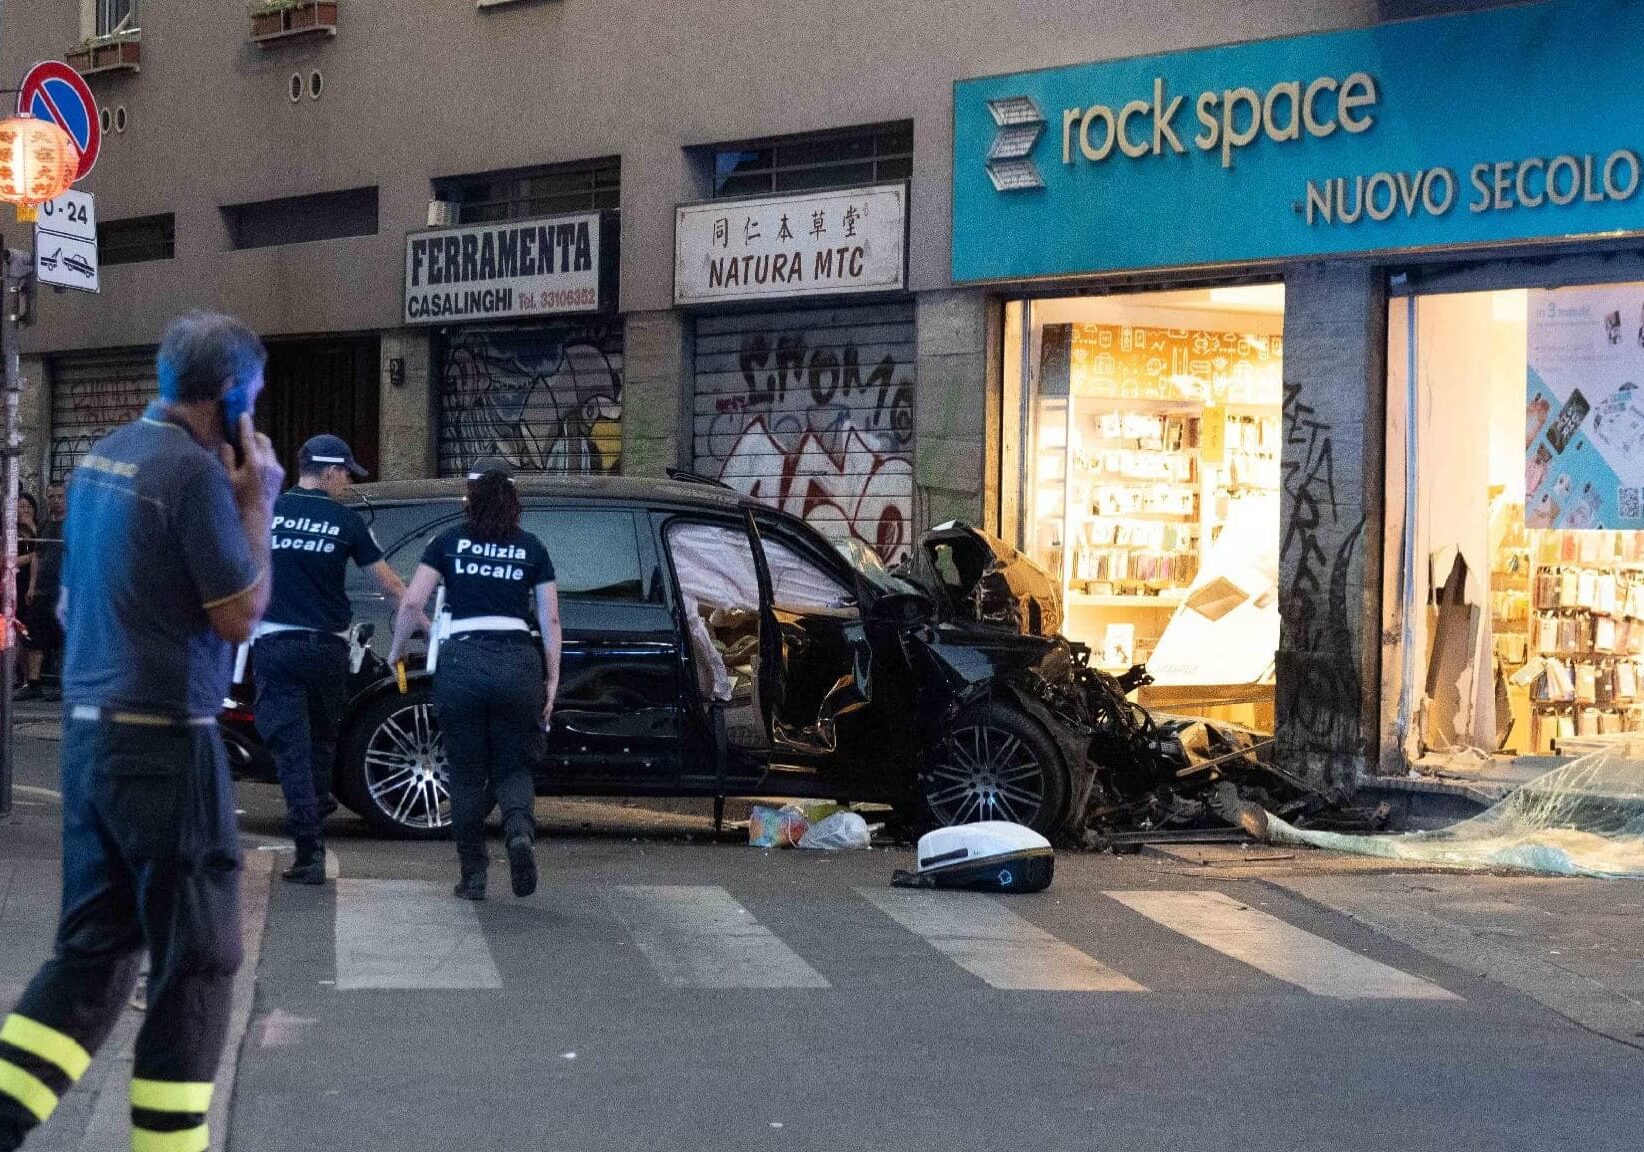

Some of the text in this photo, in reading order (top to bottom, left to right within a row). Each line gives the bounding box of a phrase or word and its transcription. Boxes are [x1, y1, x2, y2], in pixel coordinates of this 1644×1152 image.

[1062, 71, 1377, 170] rock space
[1306, 149, 1640, 226] NUOVO SECOLO
[67, 201, 88, 225] 24
[712, 204, 860, 249] 同仁本草堂
[411, 222, 592, 287] FERRAMENTA
[709, 246, 863, 288] NATURA MTC
[408, 288, 513, 318] CASALINGHI
[271, 516, 341, 537] Polizia
[271, 535, 336, 553] Locale
[456, 538, 527, 560] Polizia
[454, 558, 524, 580] Locale
